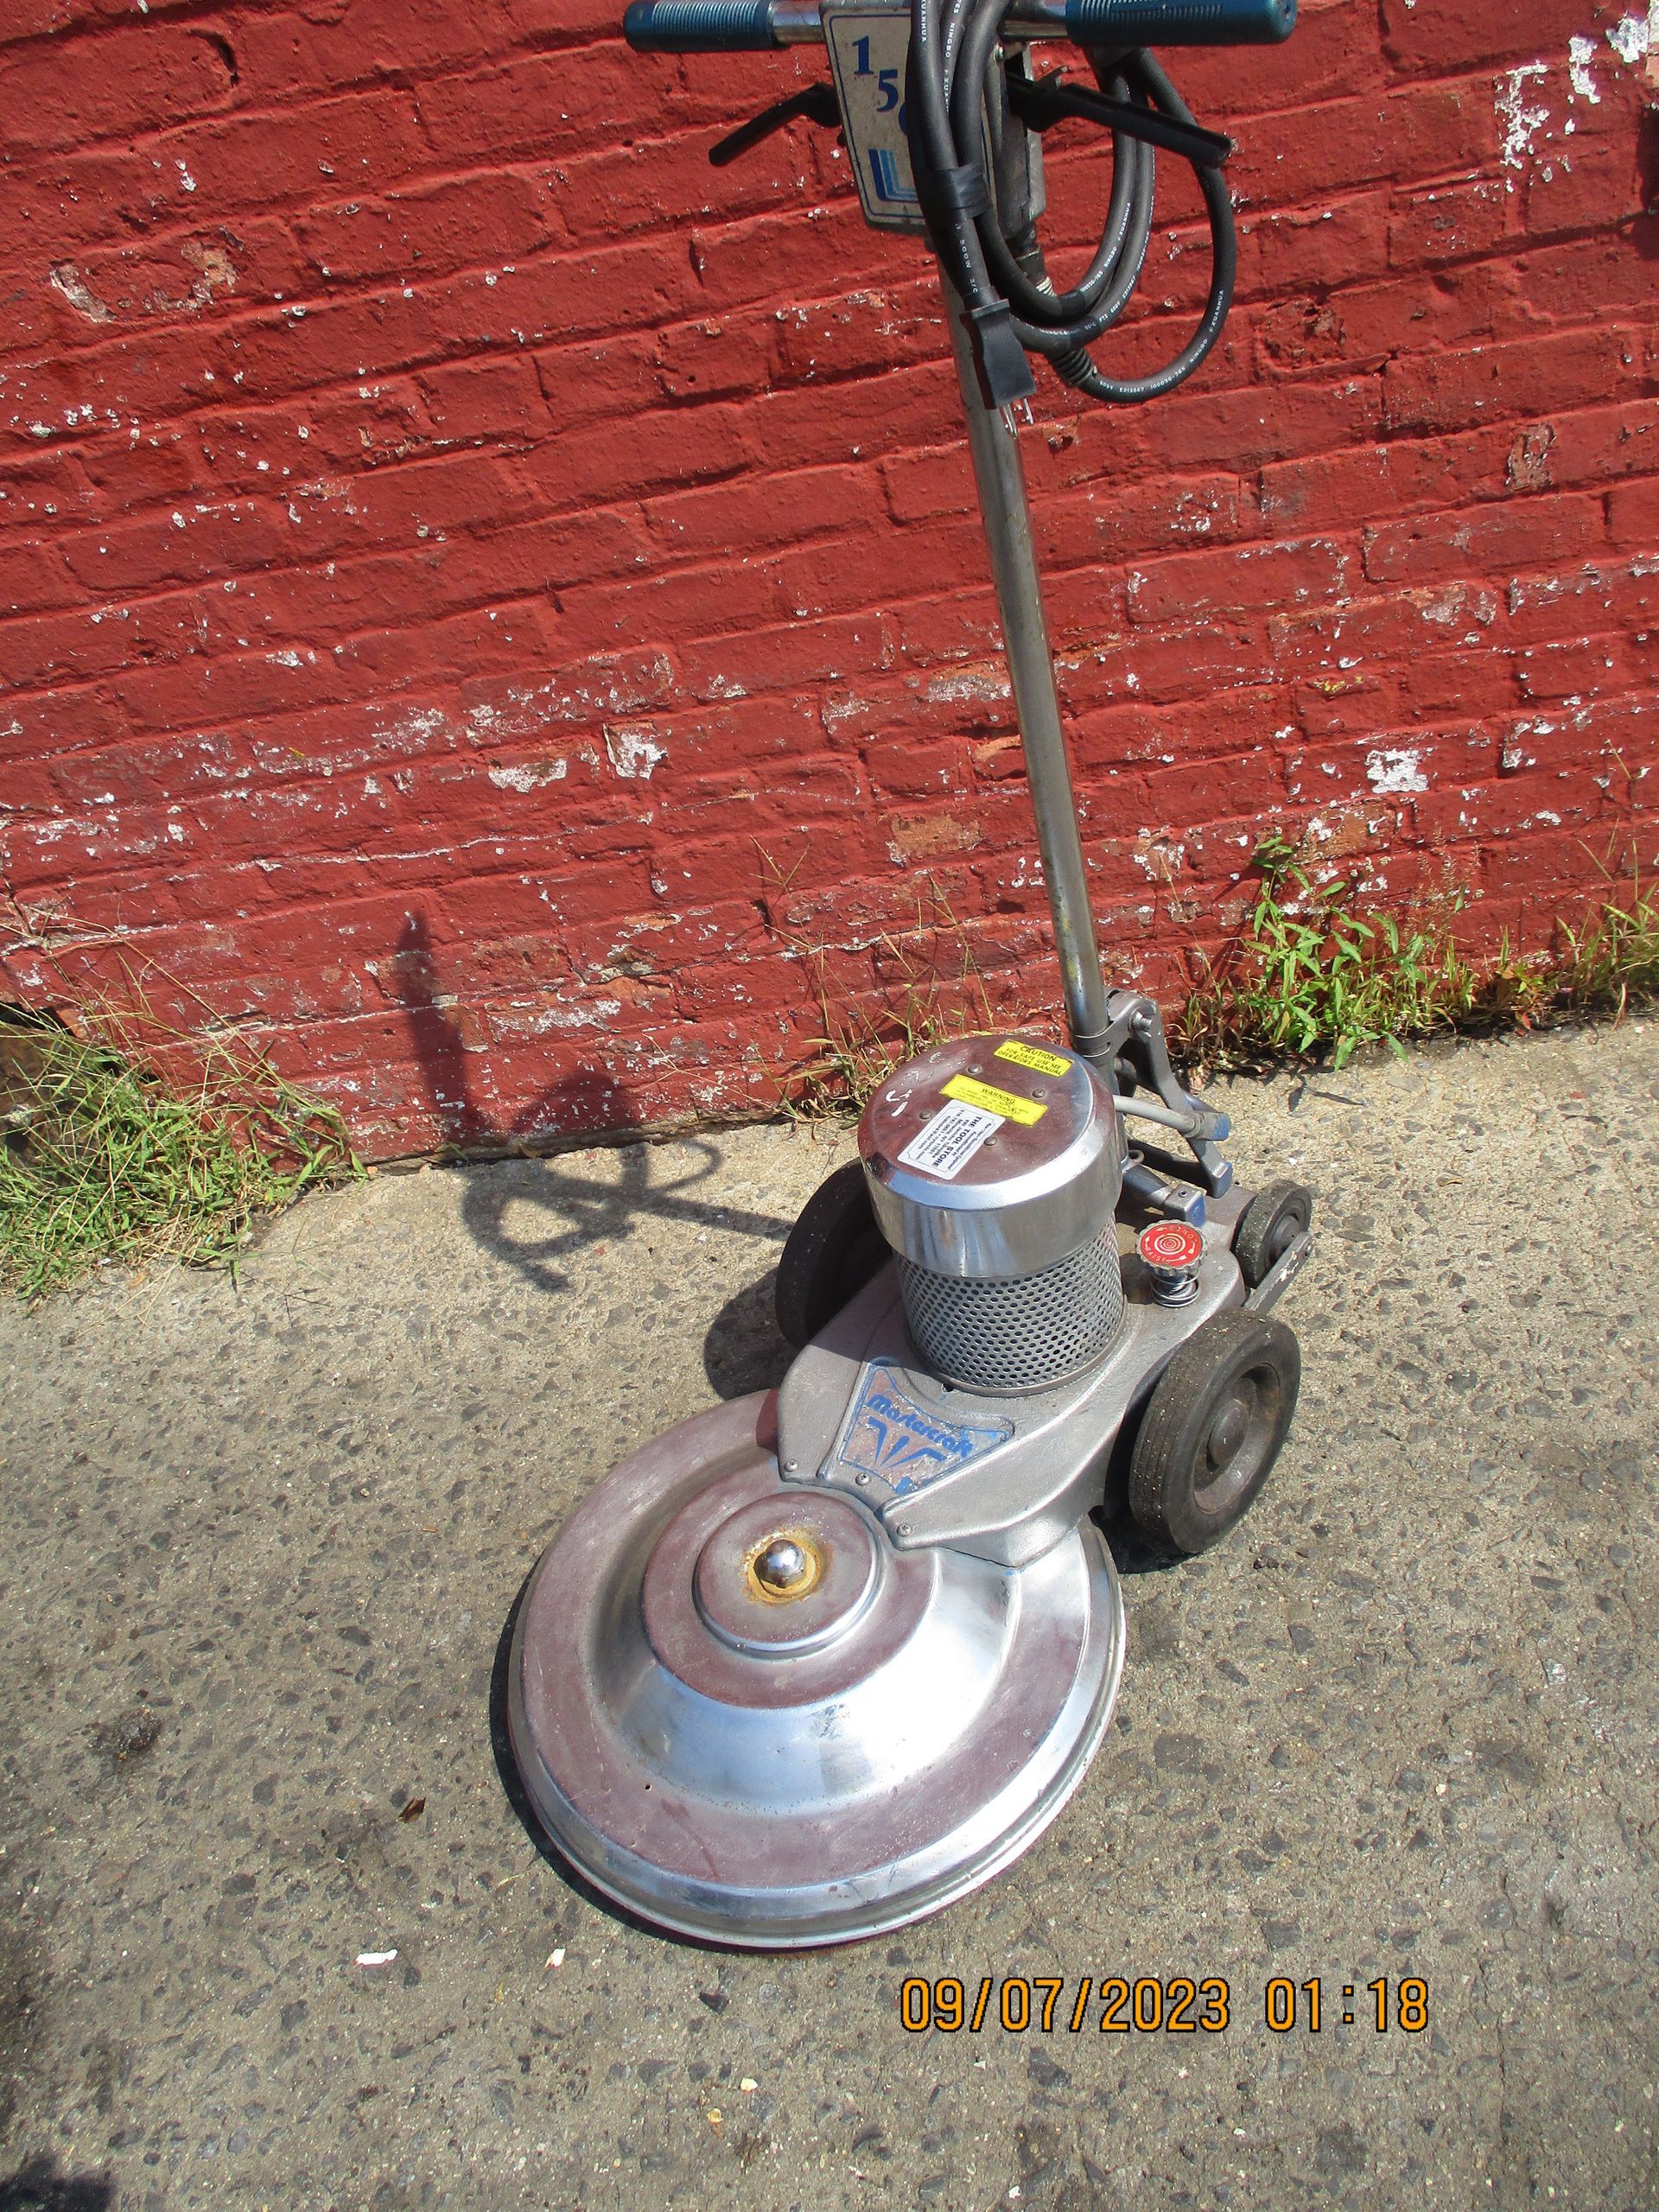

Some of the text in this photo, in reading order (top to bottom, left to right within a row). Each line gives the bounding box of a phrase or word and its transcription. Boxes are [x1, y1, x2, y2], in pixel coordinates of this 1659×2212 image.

[945, 22, 956, 58] NINGBO
[959, 239, 971, 268] SOOW
[1099, 380, 1114, 390] 600V
[1189, 339, 1208, 364] NINGBO
[1211, 289, 1224, 327] XUANHUA
[1020, 1046, 1057, 1061] CAUTION
[1033, 1063, 1062, 1075] MANUAL
[982, 1088, 1016, 1104] WARNING
[931, 1116, 982, 1167] THE TOOL STORE
